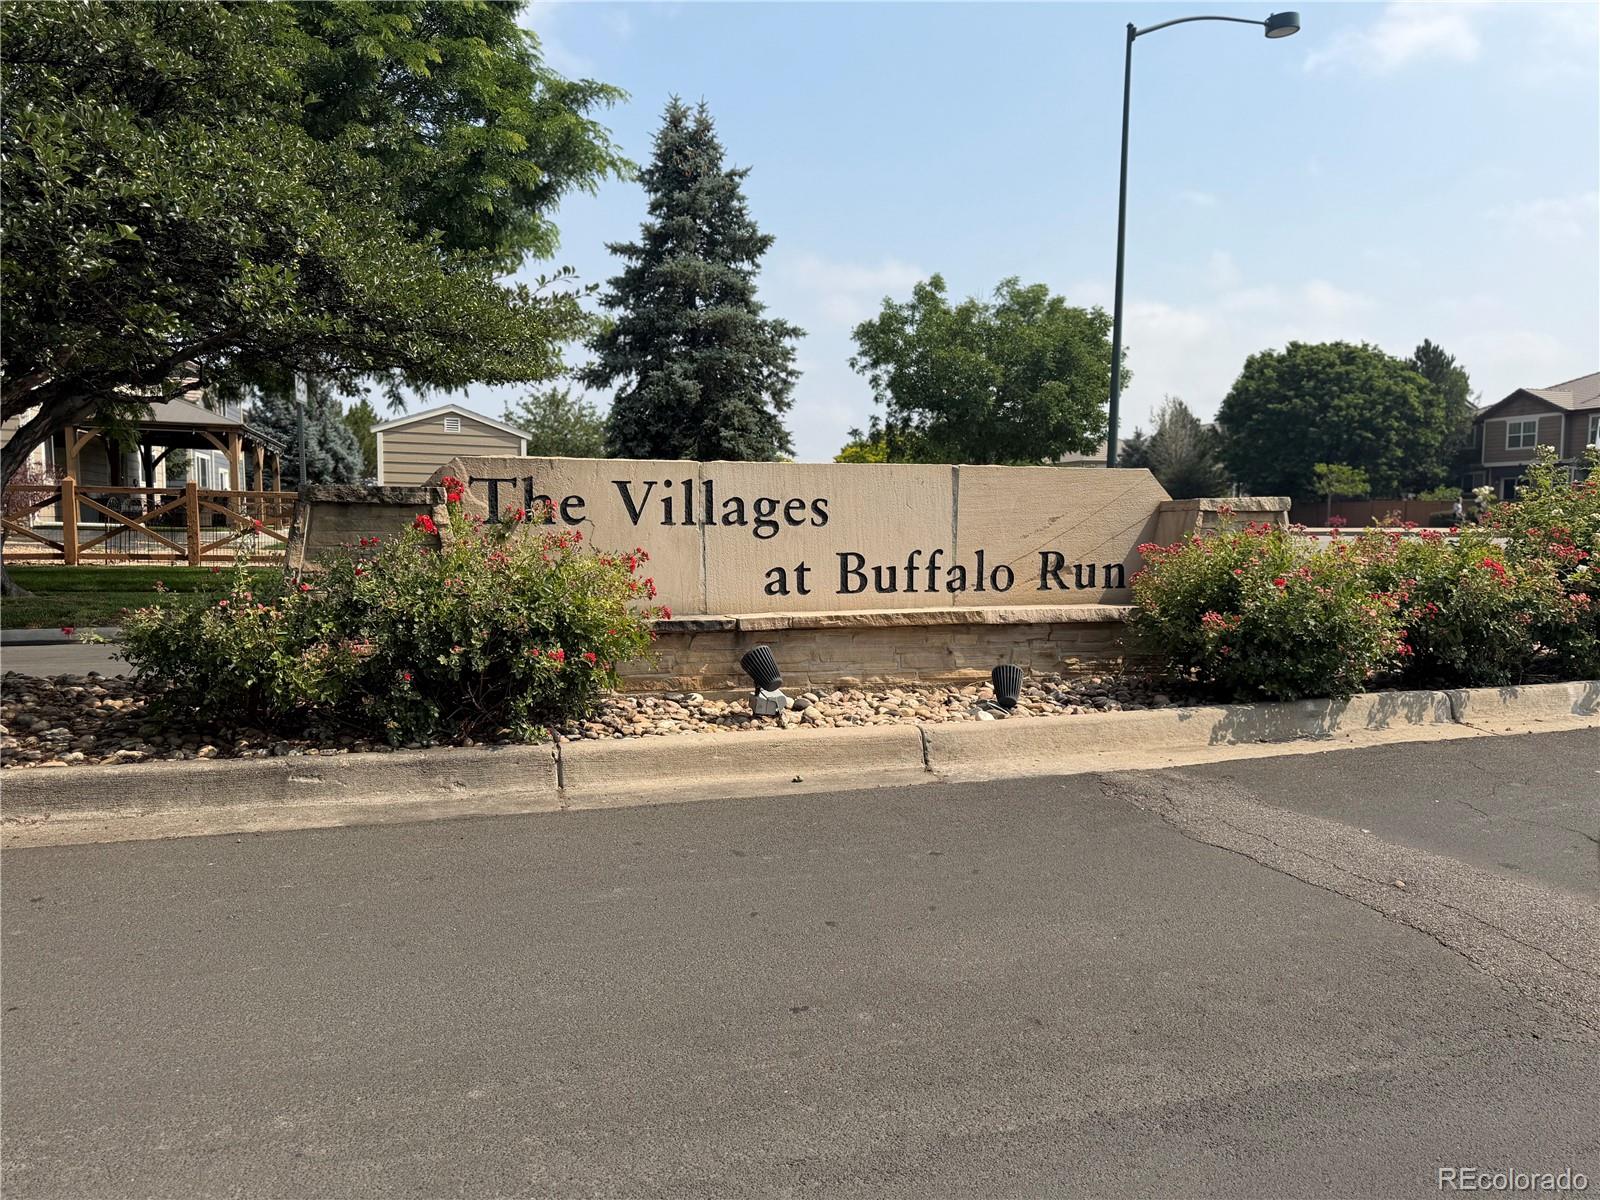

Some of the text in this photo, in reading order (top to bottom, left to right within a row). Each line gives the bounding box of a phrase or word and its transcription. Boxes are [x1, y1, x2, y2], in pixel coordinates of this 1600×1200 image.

[469, 476, 830, 540] The Villages
[764, 548, 1127, 596] at Buffalo Run
